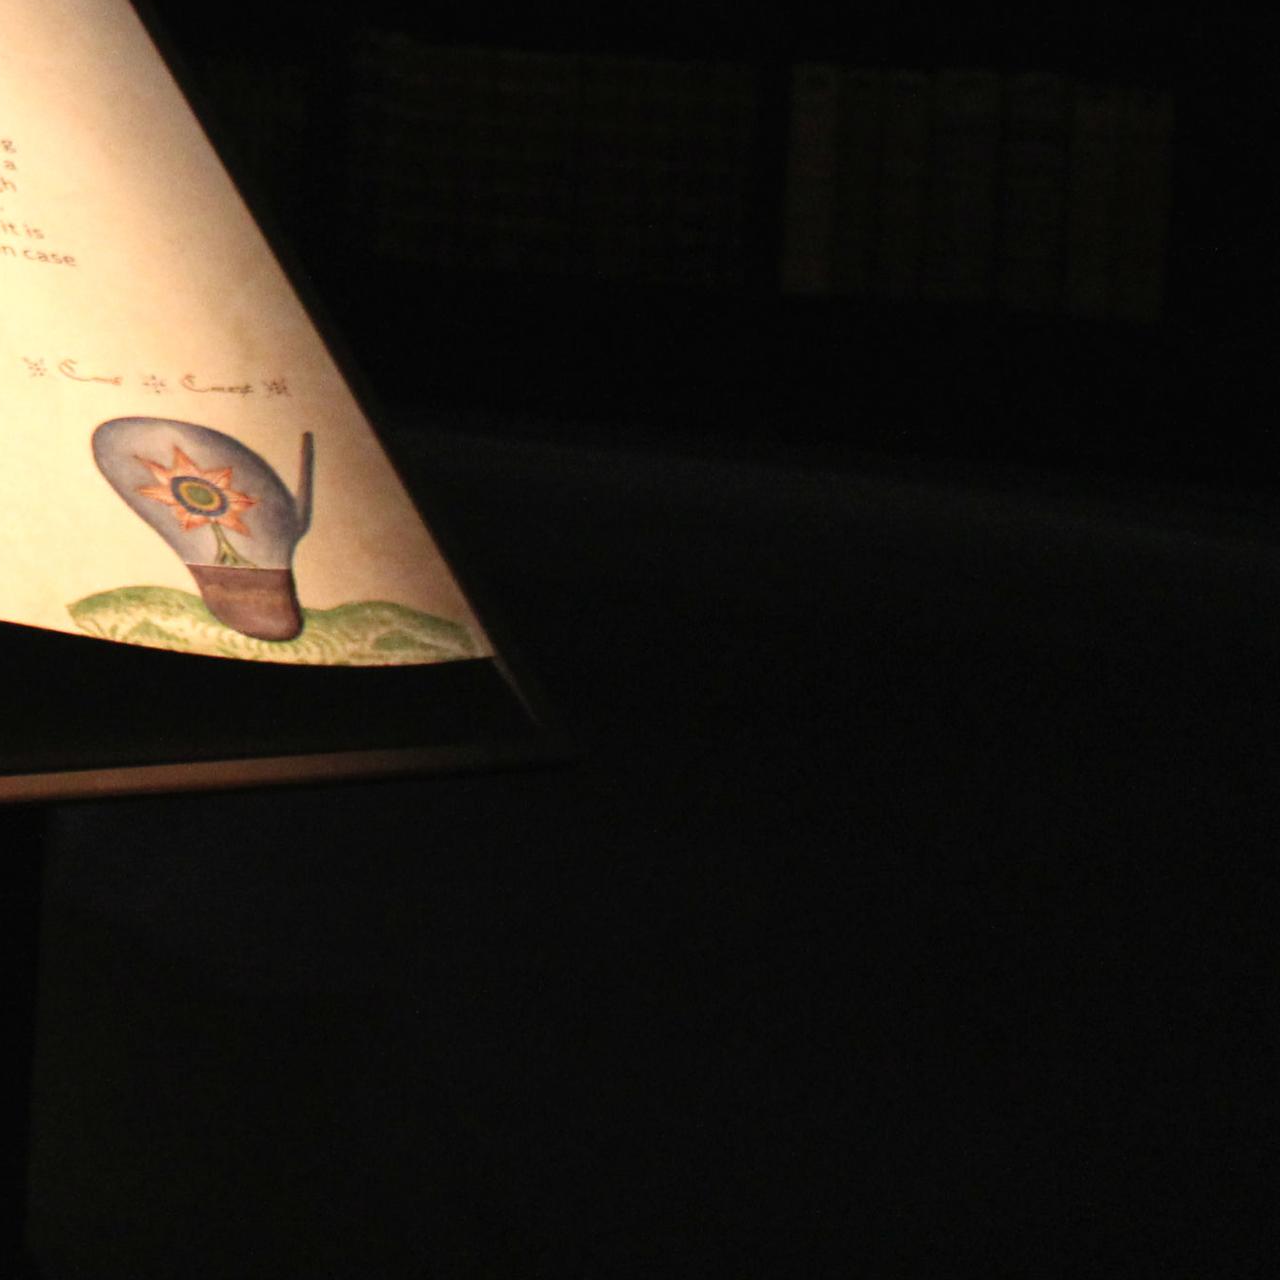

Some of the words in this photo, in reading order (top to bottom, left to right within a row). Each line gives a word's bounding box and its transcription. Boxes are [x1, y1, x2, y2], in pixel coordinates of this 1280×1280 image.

[2, 159, 17, 172] a
[0, 219, 21, 236] it
[22, 222, 46, 241] is
[21, 248, 78, 268] case
